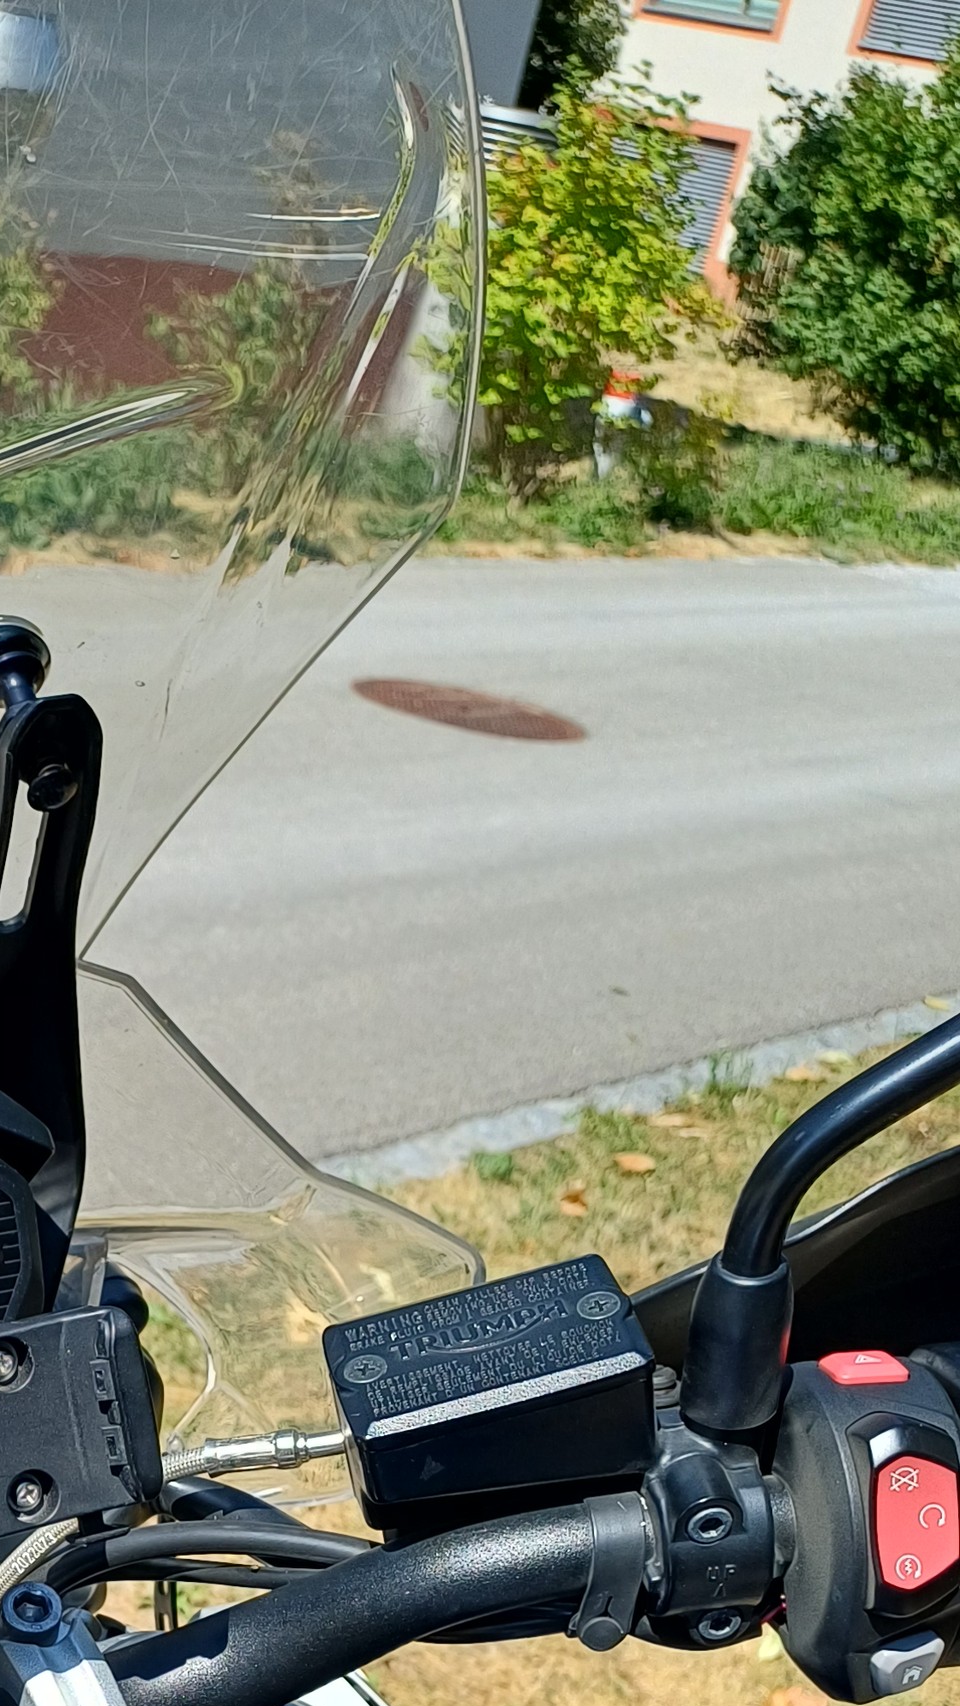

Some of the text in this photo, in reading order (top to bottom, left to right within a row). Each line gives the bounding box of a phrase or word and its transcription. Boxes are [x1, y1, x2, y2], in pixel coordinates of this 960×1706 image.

[345, 1310, 422, 1342] WARNING
[388, 1299, 568, 1361] TRIUMPH
[390, 1325, 424, 1341] FLUID
[540, 1334, 553, 1345] LE
[706, 1563, 737, 1580] UP
